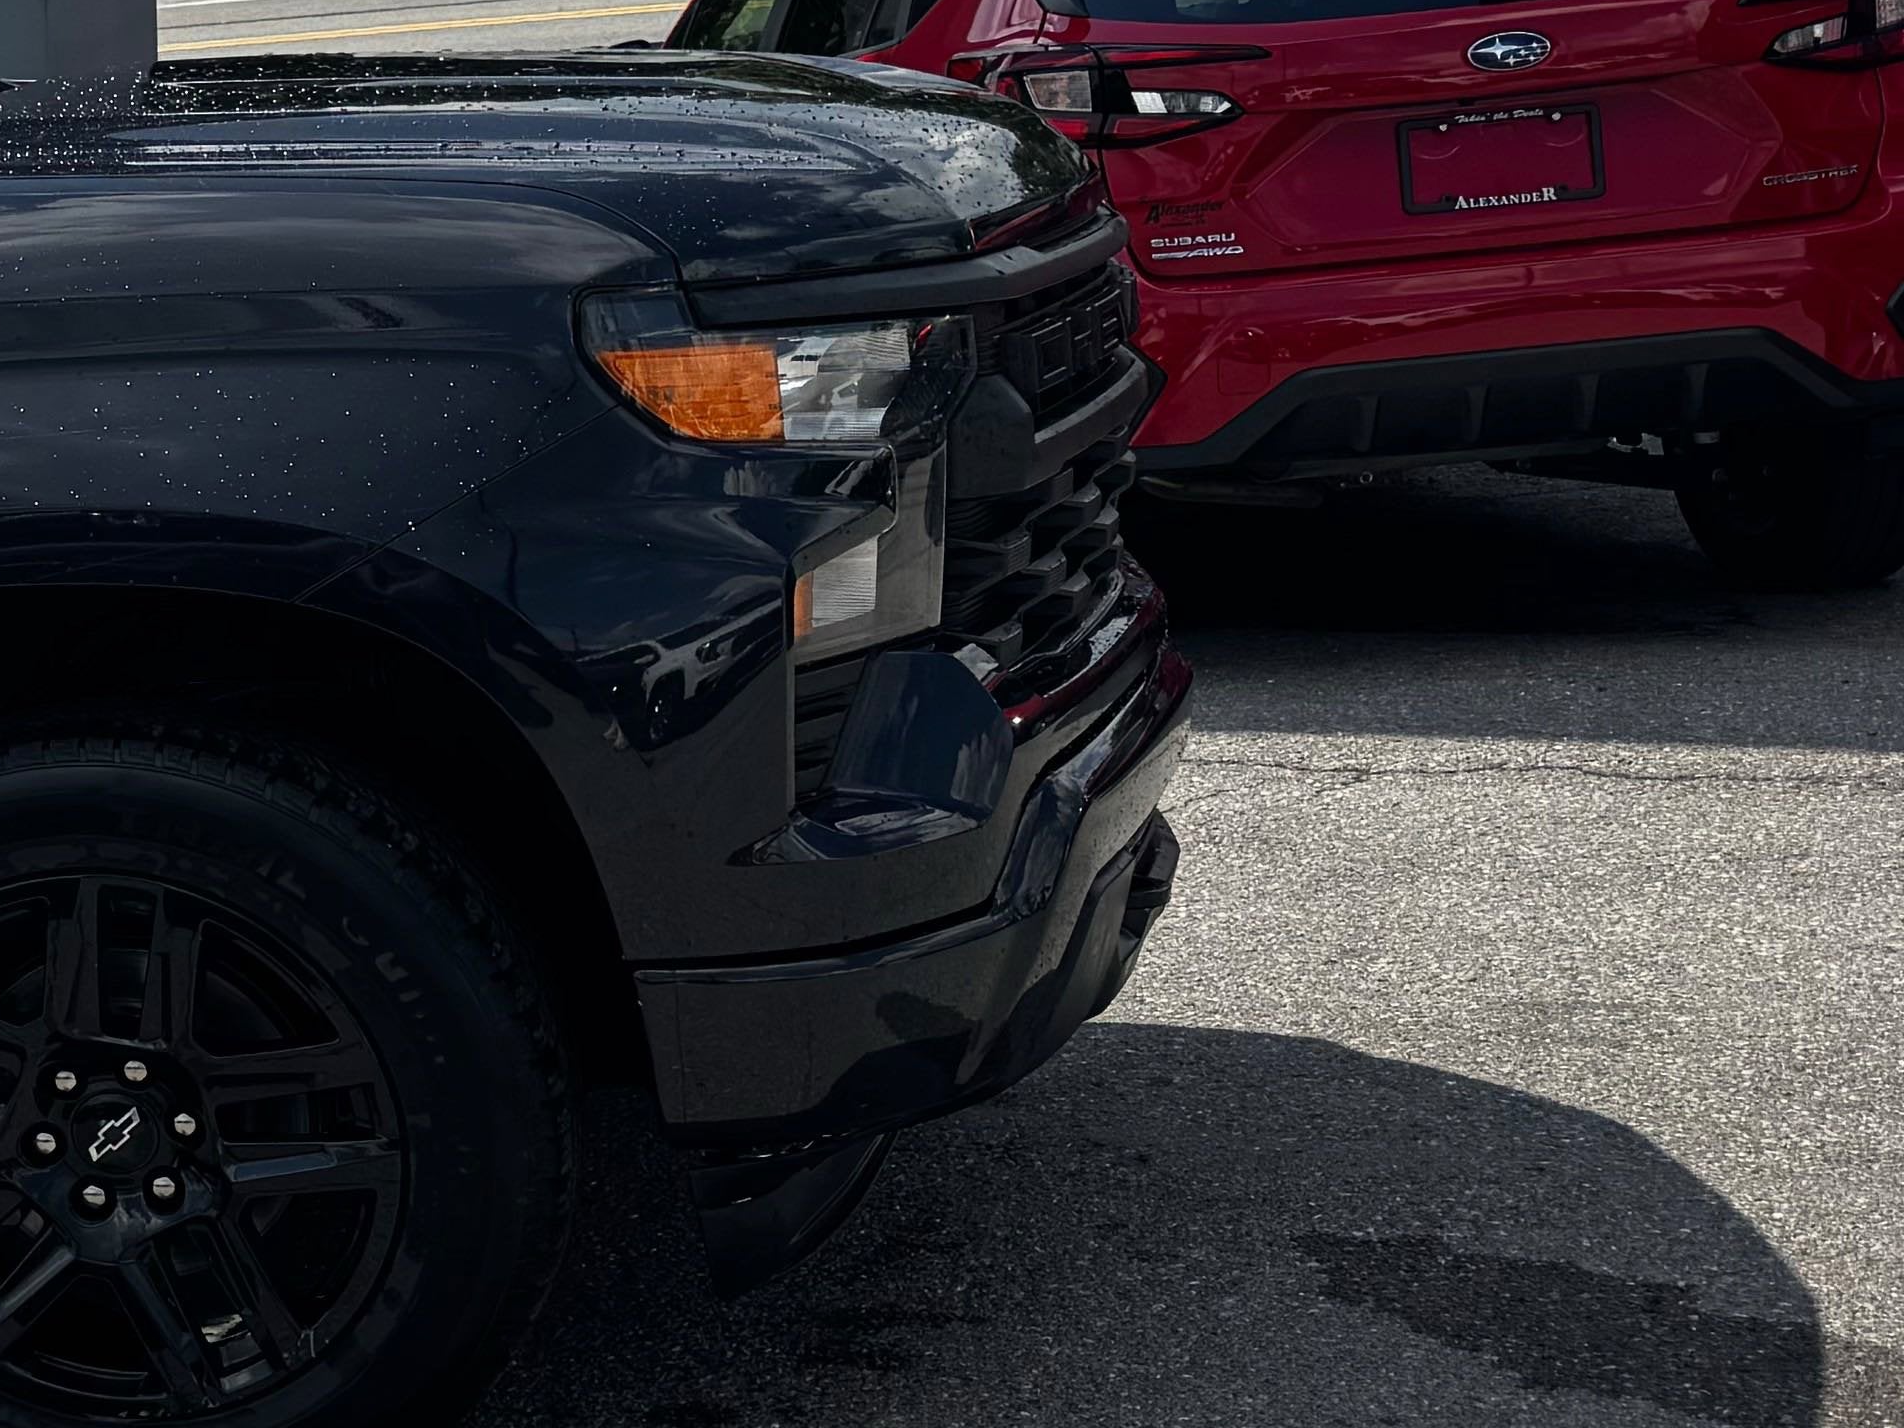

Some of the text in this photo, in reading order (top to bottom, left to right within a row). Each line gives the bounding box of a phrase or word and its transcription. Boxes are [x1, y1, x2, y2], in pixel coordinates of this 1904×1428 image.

[1454, 187, 1557, 210] ALEXANDER
[1150, 232, 1235, 247] SUBARU
[1188, 246, 1244, 257] AWD
